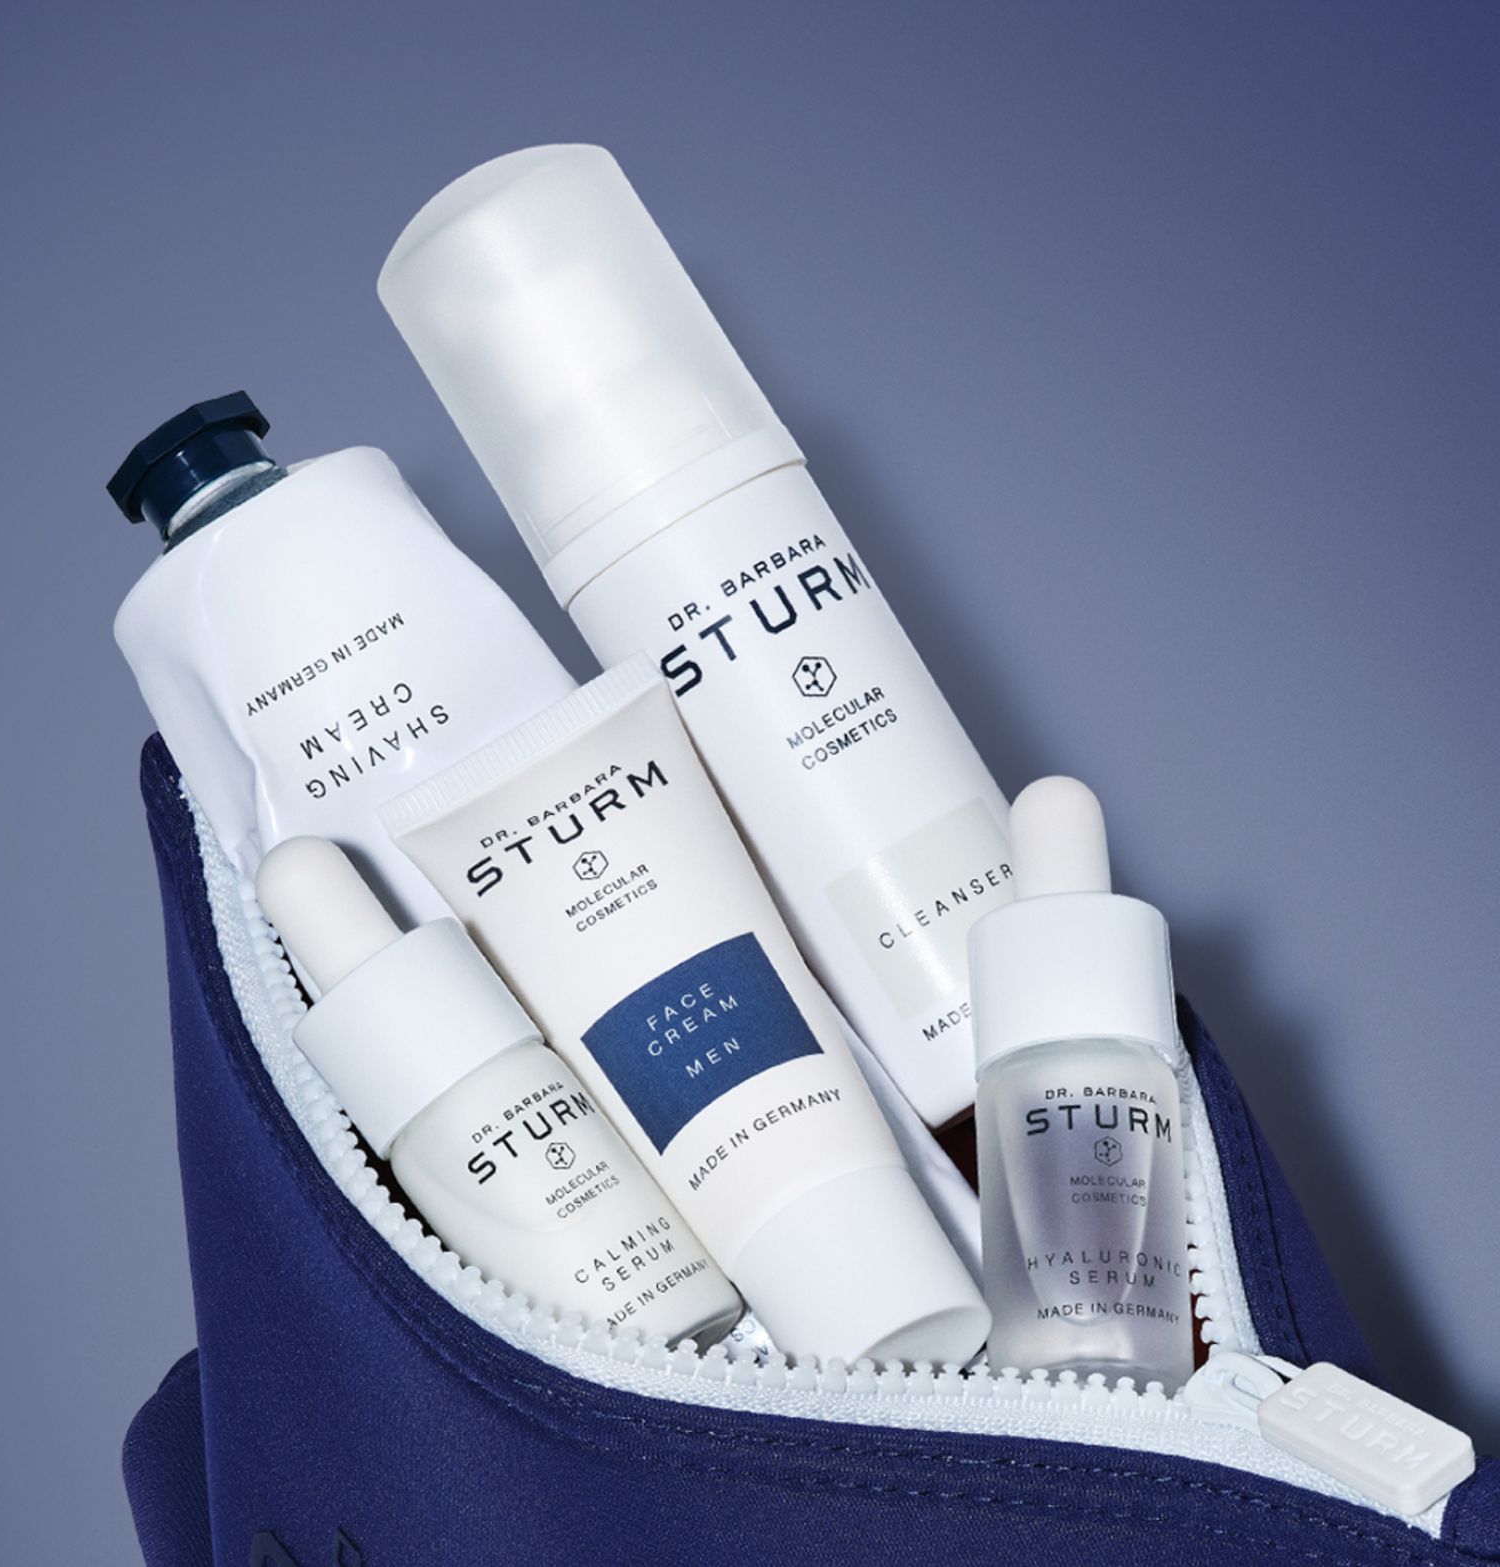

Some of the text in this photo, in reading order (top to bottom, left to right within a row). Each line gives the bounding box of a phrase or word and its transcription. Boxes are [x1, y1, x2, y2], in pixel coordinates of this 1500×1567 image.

[667, 534, 827, 631] DR. BARBARA
[660, 552, 871, 698] STURM
[245, 612, 405, 716] MADE IN GERMANY
[299, 682, 413, 760] CREAM
[786, 686, 885, 749] MOLECULAR
[801, 707, 898, 770] COSMETICS
[305, 704, 450, 799] SHAVING
[466, 759, 669, 897] STURM
[479, 764, 622, 849] DR. BARBARA
[565, 863, 650, 918] MOLECULAR
[575, 878, 658, 933] COSMETICS
[878, 863, 1014, 949] CLEANSER
[646, 983, 714, 1032] FACE
[647, 995, 738, 1057] CREAM
[922, 1002, 972, 1041] MADE
[685, 1038, 740, 1079] MEN
[471, 1081, 564, 1145] DR. BARBARA
[1025, 1103, 1172, 1143] STURM
[1045, 1086, 1157, 1104] DR. BARBARA
[467, 1091, 596, 1185] STURM
[688, 1088, 841, 1191] MADE IN GERMANY
[545, 1160, 610, 1206] MOLECULAR
[556, 1174, 620, 1219] COSMETICS
[1069, 1175, 1147, 1189] MOLECULAR
[1071, 1192, 1148, 1207] COSMETICS
[574, 1215, 671, 1284] CALMING
[601, 1239, 675, 1292] SERUM
[1027, 1250, 1181, 1278] HYALURONIC
[1069, 1270, 1155, 1288] SERUM
[606, 1301, 637, 1331] ADE
[636, 1288, 656, 1306] IN
[1037, 1302, 1084, 1320] MADE
[1090, 1302, 1108, 1314] IN
[1278, 1386, 1433, 1471] STURM
